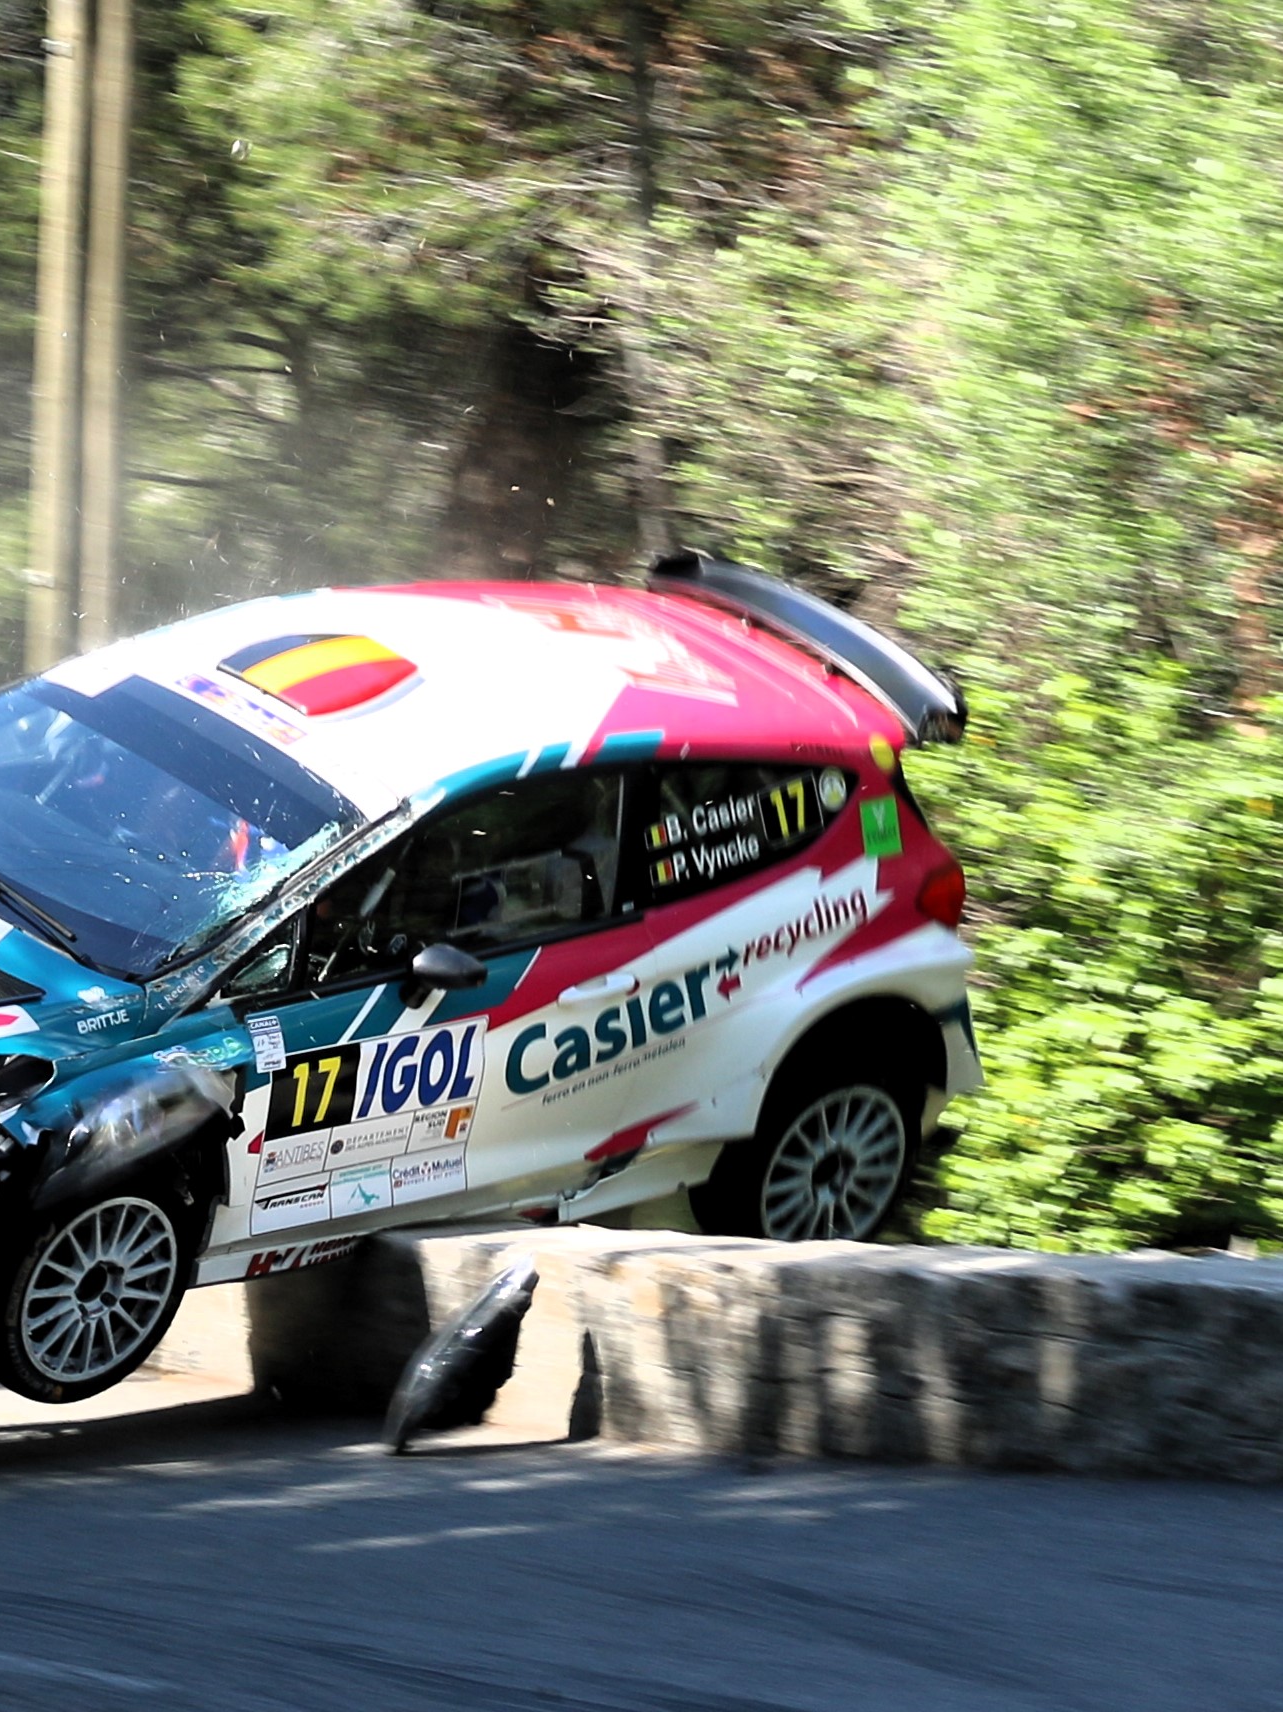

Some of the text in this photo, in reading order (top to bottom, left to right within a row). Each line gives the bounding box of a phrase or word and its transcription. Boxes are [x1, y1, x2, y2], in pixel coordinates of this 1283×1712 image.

[692, 793, 756, 836] Casier
[770, 778, 806, 839] 17
[691, 832, 760, 880] Vyncke
[742, 887, 868, 970] recycling
[77, 1009, 130, 1034] BRITTJE
[505, 957, 713, 1096] Casier
[291, 1056, 341, 1127] 17
[356, 1024, 477, 1119] IGOL
[276, 1141, 324, 1163] ANTIBES
[393, 1166, 420, 1181] Crédit
[432, 1156, 463, 1171] Mutuel
